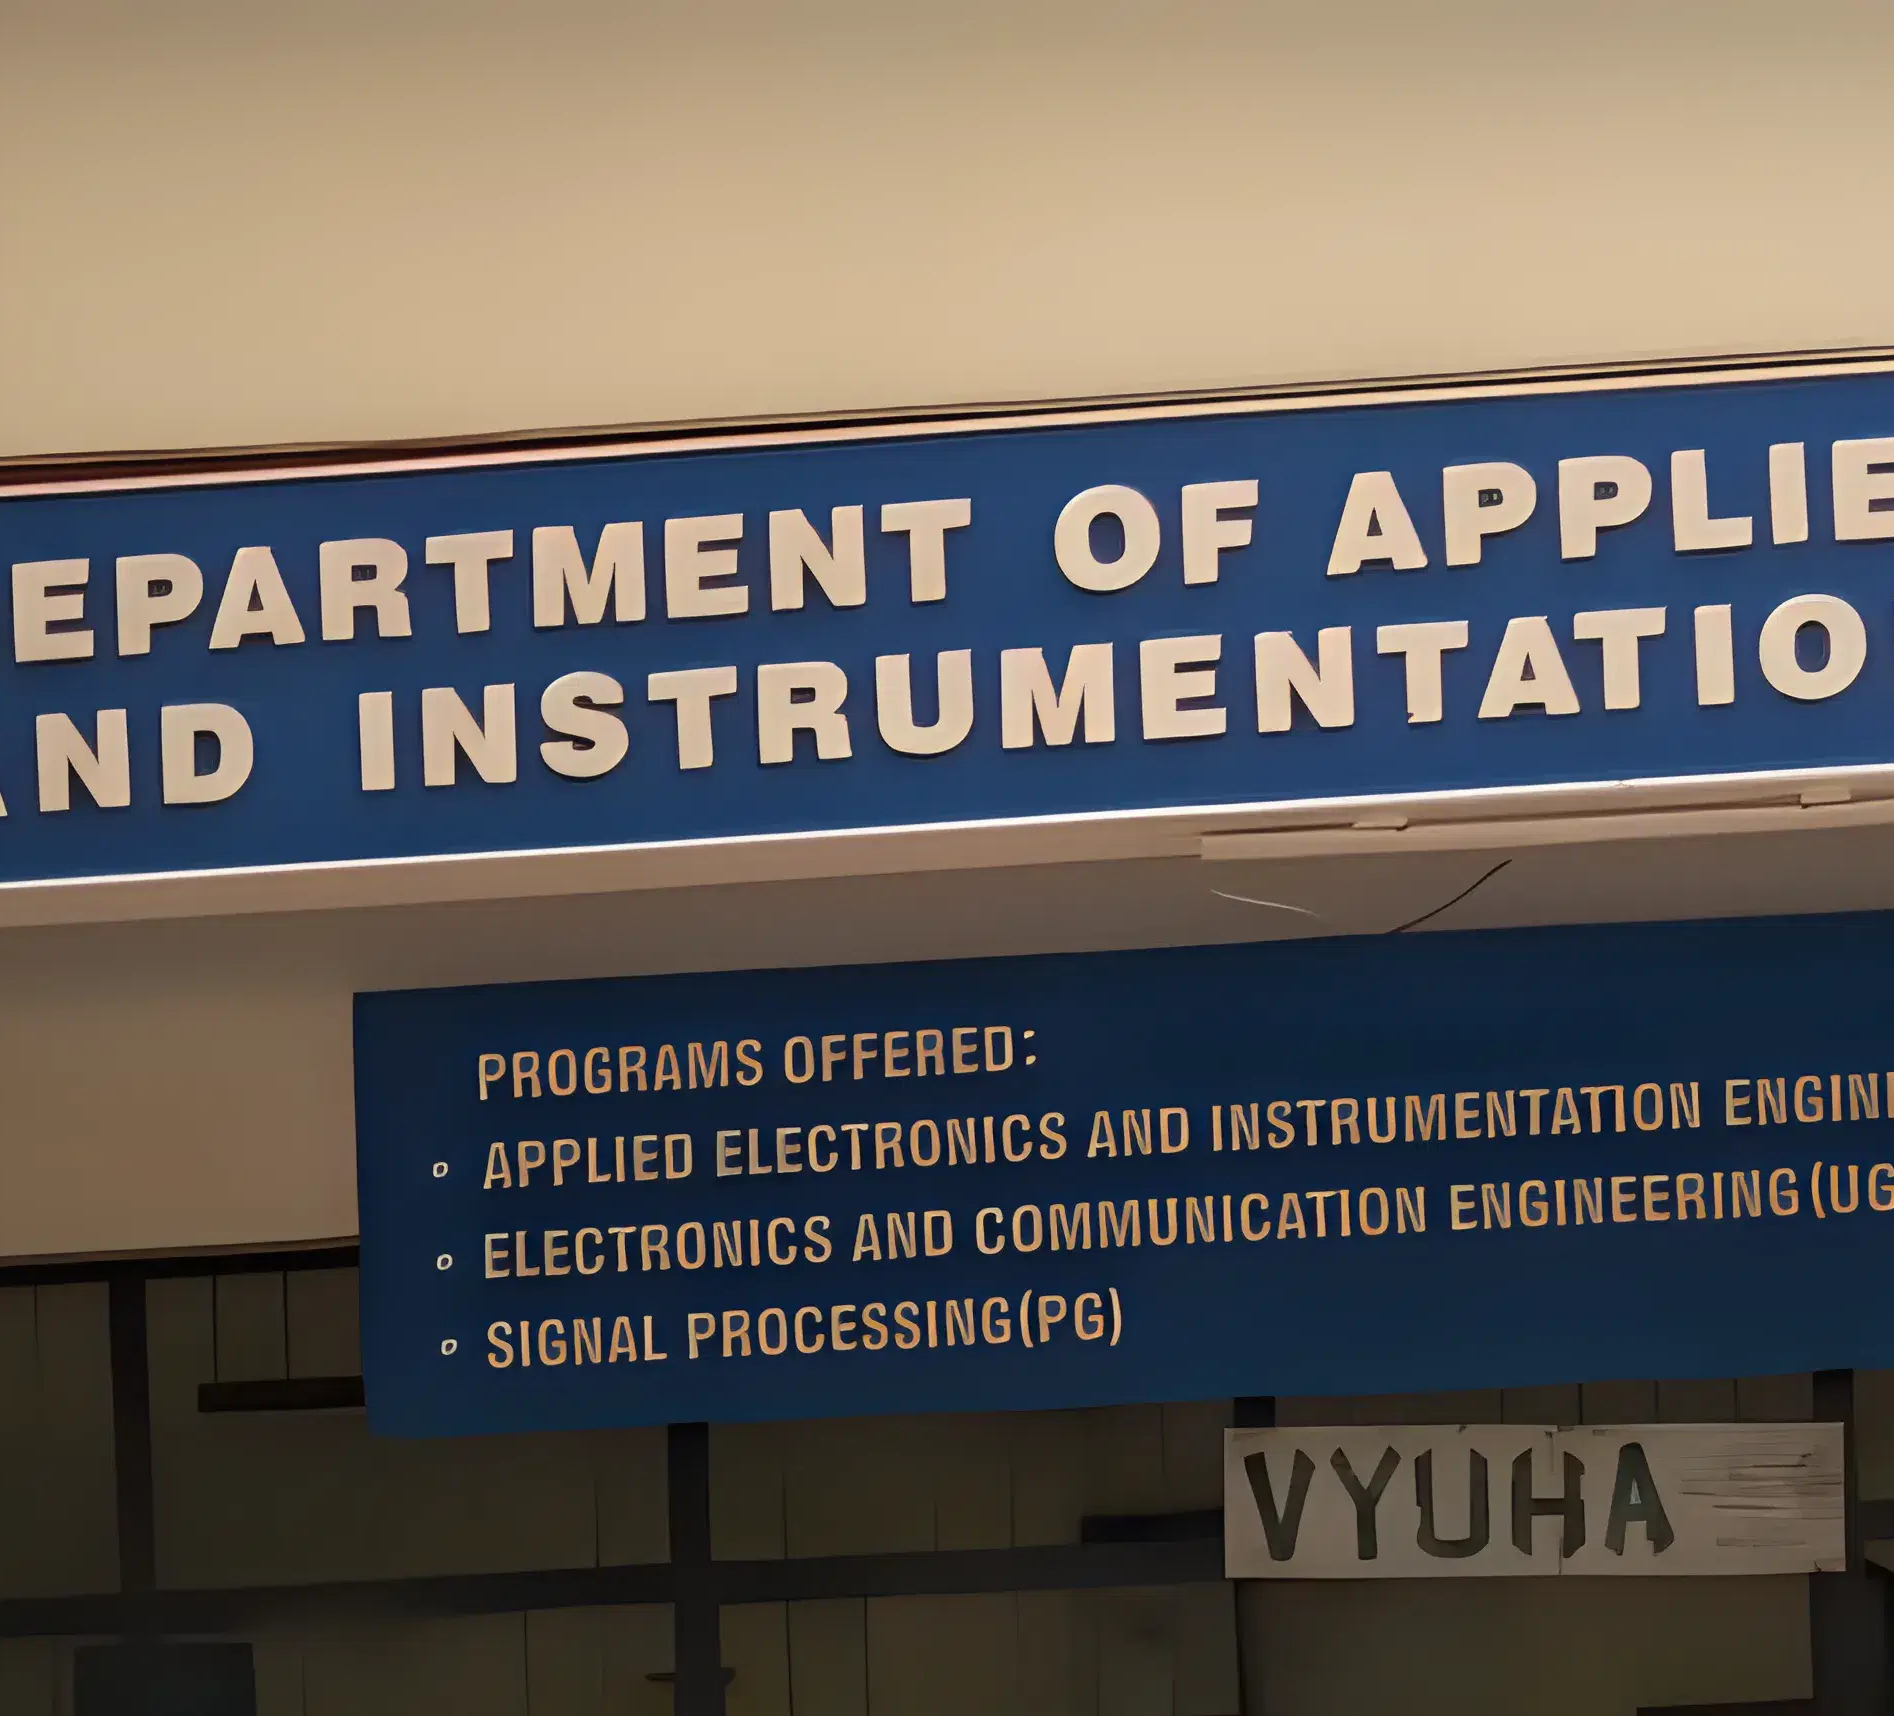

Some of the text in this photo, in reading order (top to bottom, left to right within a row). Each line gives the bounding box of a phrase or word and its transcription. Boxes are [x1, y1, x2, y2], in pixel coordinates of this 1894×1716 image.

[1054, 480, 1258, 591] OF
[477, 1024, 1037, 1102] PROGRAMS OFFERED:
[483, 1132, 694, 1190] APPLIED
[716, 1111, 1068, 1178] ELECTRONICS
[1086, 1106, 1190, 1159] AND
[1210, 1080, 1701, 1153] INSTRUMENTATION
[484, 1215, 833, 1280] ELECTRONICS
[851, 1209, 954, 1262] AND
[975, 1185, 1427, 1256] COMMUNICATION
[486, 1286, 1123, 1369] SIGNAL PROCESSING(PG)
[1243, 1441, 1675, 1561] VYUHA
